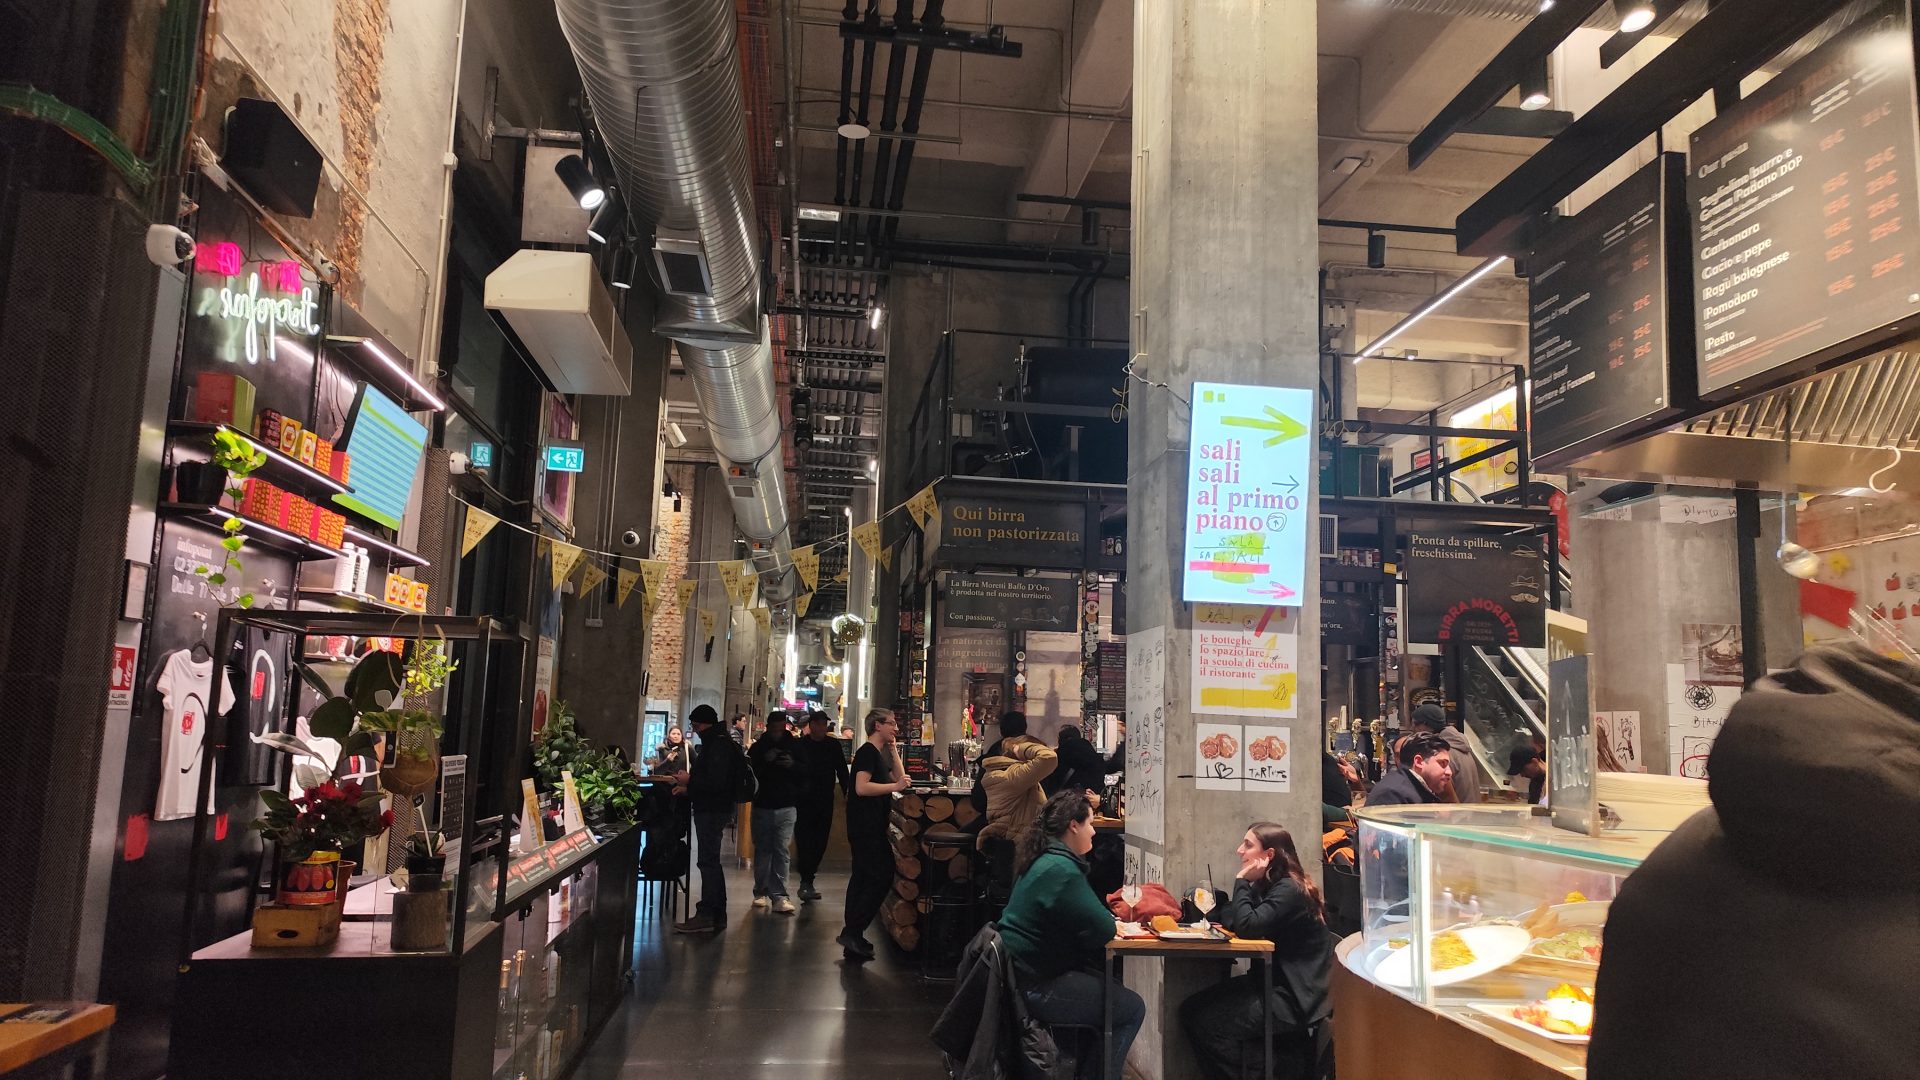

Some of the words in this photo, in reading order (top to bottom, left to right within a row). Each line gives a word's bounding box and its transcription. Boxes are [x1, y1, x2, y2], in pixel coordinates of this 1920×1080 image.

[1749, 153, 1783, 178] burro
[1786, 148, 1793, 158] e
[1734, 172, 1778, 203] Padano
[1779, 155, 1803, 179] DOP
[1700, 222, 1760, 260] Carbonara
[1702, 257, 1733, 280] Cacio
[1742, 238, 1772, 262] pepe
[1731, 250, 1790, 286] bolognese
[1704, 288, 1758, 321] Pomodoro
[1704, 330, 1735, 351] Pesto
[1199, 438, 1241, 461] sali
[1198, 462, 1240, 484] sali
[1197, 484, 1218, 506] al
[1228, 487, 1300, 513] primo
[953, 505, 982, 522] Qui
[988, 507, 1025, 522] birra
[1195, 508, 1264, 534] piano
[953, 527, 982, 538] non
[987, 527, 1080, 542] pastorizzata
[1411, 534, 1445, 546] Pronta
[1447, 535, 1460, 546] da
[1463, 537, 1503, 550] spillare,
[1411, 547, 1477, 561] freschissima.
[951, 579, 960, 587] La
[962, 580, 980, 588] Birra
[981, 581, 1006, 590] Moretti
[1007, 582, 1026, 591] Baffo
[1028, 583, 1050, 592] D'Oro
[955, 588, 984, 597] prodotta
[986, 589, 997, 597] nel
[1320, 597, 1337, 605] lano.
[949, 611, 964, 620] Con
[965, 613, 997, 622] passione.
[1438, 600, 1470, 639] BIRRA
[1471, 597, 1519, 643] MORETTI
[937, 636, 950, 645] La
[952, 637, 983, 645] natura
[985, 637, 994, 645] ci
[1200, 634, 1209, 644] le
[1211, 634, 1252, 648] botteghe
[1200, 644, 1209, 655] lo
[1212, 646, 1244, 658] spazio
[937, 660, 952, 668] noi
[954, 660, 963, 668] ci
[965, 660, 1009, 669] mettiamo
[1200, 656, 1209, 666] la
[1212, 657, 1243, 668] scuola
[1245, 658, 1255, 668] di
[1257, 659, 1290, 670] cucina
[1200, 667, 1208, 677] il
[1209, 668, 1256, 679] ristorante
